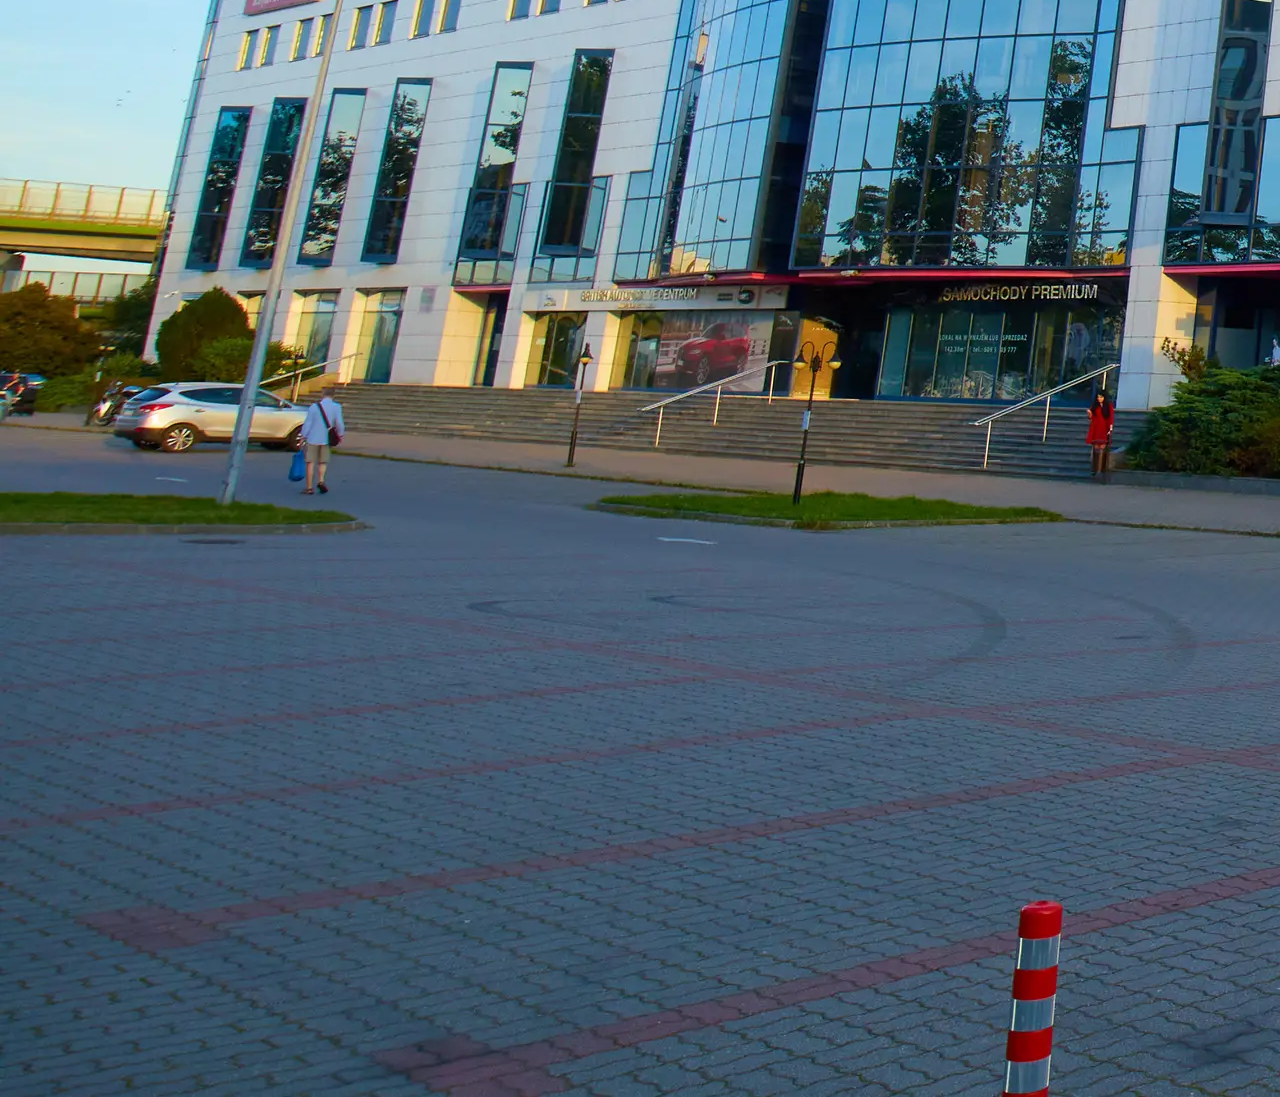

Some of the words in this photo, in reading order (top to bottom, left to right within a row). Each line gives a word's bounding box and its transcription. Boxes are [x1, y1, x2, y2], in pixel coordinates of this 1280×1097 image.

[658, 288, 697, 301] CENTRUM
[942, 285, 1028, 301] SAMOCHODY
[1031, 284, 1098, 299] PREMIUM
